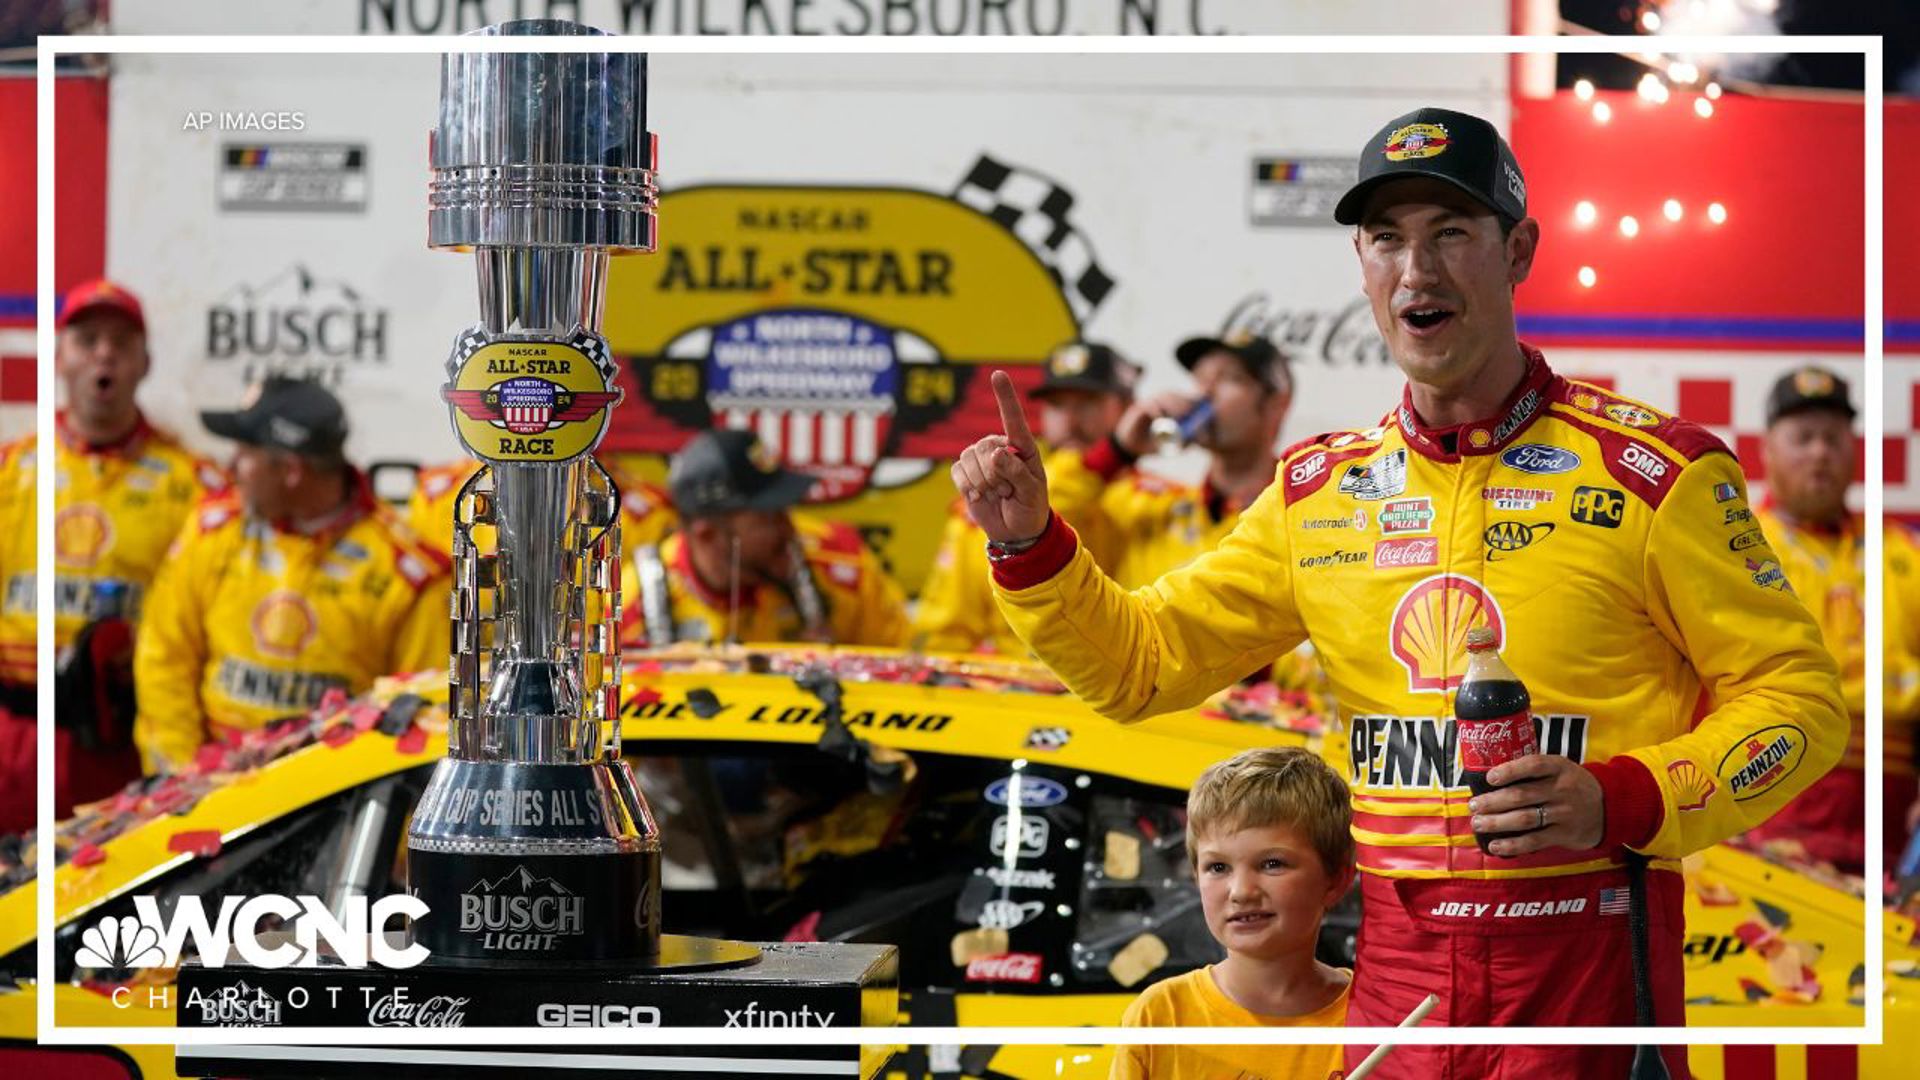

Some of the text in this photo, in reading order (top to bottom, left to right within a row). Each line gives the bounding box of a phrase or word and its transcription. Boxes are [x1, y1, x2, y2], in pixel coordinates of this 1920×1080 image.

[205, 303, 389, 363] BUSCH
[508, 348, 547, 356] NASCAR
[486, 394, 498, 403] 20
[499, 438, 554, 455] RACE
[1290, 455, 1326, 482] OMP
[1515, 449, 1563, 470] Ford
[1622, 446, 1666, 478] OMP
[1481, 487, 1554, 502] DISCOUNT
[1498, 500, 1531, 510] TIRE
[1382, 511, 1430, 521] BROTHERS
[1392, 503, 1419, 512] HUNT
[1572, 492, 1624, 521] PPG
[1392, 520, 1420, 530] PIZZA
[1490, 527, 1527, 550] AAA
[1300, 551, 1367, 568] GOODYEAR
[1376, 541, 1436, 567] Coca-Cola
[1458, 720, 1512, 741] Coca-Cola
[1730, 735, 1792, 794] PENNZOIL
[446, 788, 479, 824] CUP
[480, 789, 544, 826] SERIES
[551, 789, 585, 826] ALL
[460, 894, 584, 935] BUSCH
[1431, 898, 1587, 917] JOEY LOGANO
[483, 933, 556, 950] LIGHT
[201, 999, 282, 1025] BUSCH
[368, 994, 470, 1028] Coca-Cola
[537, 1004, 660, 1028] GEICO
[723, 1001, 835, 1028] xfinity
